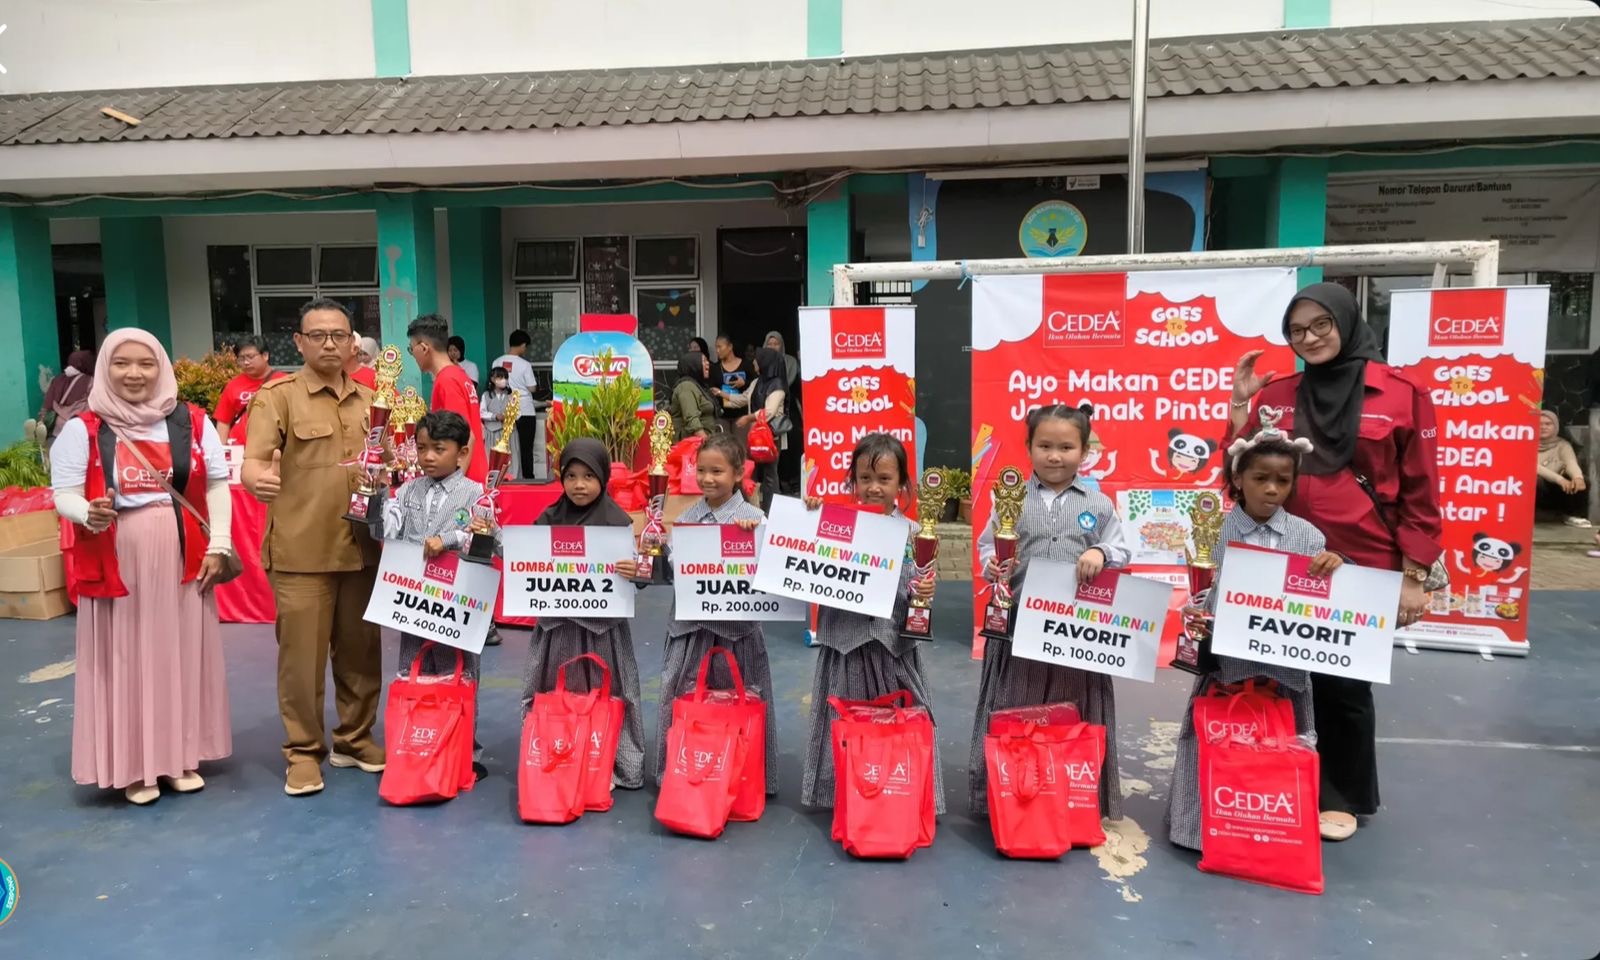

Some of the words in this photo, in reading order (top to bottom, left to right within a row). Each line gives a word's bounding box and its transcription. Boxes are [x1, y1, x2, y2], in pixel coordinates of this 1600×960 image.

[1378, 185, 1406, 196] Nomor
[1408, 183, 1441, 195] Telepon
[1048, 310, 1121, 332] CEDEA
[1151, 306, 1203, 323] GOES
[1434, 316, 1499, 334] CEDEA
[1134, 326, 1219, 348] SCHOOL
[1170, 322, 1183, 331] To
[834, 332, 882, 347] CEDEA
[838, 376, 880, 392] GOES
[1008, 369, 1058, 399] Ayo
[1068, 368, 1158, 392] Makan
[1170, 366, 1235, 392] CEDE
[1434, 365, 1493, 382] GOES
[855, 390, 864, 398] To
[1430, 387, 1510, 406] CHOOL
[1455, 382, 1469, 390] To
[825, 396, 894, 414] SCHOOL
[1156, 397, 1232, 421] Pinta
[808, 428, 844, 450] Ayo
[1446, 420, 1535, 440] Makan
[1437, 447, 1492, 468] EDEA
[1456, 474, 1523, 496] Anak
[820, 520, 852, 536] CEDEA
[553, 540, 583, 550] CEDEA
[769, 534, 816, 554] LOMBA
[818, 544, 894, 570] MEWARNAI
[510, 562, 554, 572] LOMBA
[556, 562, 614, 574] MEWARN
[680, 562, 724, 575] LOMBA
[785, 556, 870, 585] FAVORIT
[383, 572, 424, 592] LOMBA
[424, 584, 488, 612] MEWARNAI
[526, 578, 596, 592] JUARA
[602, 578, 614, 592] 2
[782, 577, 804, 592] Rp.
[810, 582, 864, 604] 100.000
[393, 590, 456, 622] JUARA
[463, 611, 471, 626] 1
[530, 598, 550, 611] Rp.
[554, 598, 608, 610] 300.000
[702, 601, 722, 614] Rp.
[726, 601, 780, 612] 200.000
[1026, 596, 1074, 616] LOMBA
[1076, 608, 1156, 632] MEWARNAI
[1226, 590, 1285, 612] LOMBA
[1286, 601, 1386, 630] MEWARNAI
[392, 611, 410, 624] Rp.
[414, 618, 460, 639] 400.000
[1043, 619, 1132, 648] FAVORIT
[1248, 614, 1356, 646] FAVORIT
[1042, 642, 1065, 657] Rp.
[1070, 646, 1126, 668] 100.000
[1248, 639, 1276, 656] Rp.
[1281, 644, 1352, 668] 100.000
[1214, 786, 1294, 814] CEDEA
